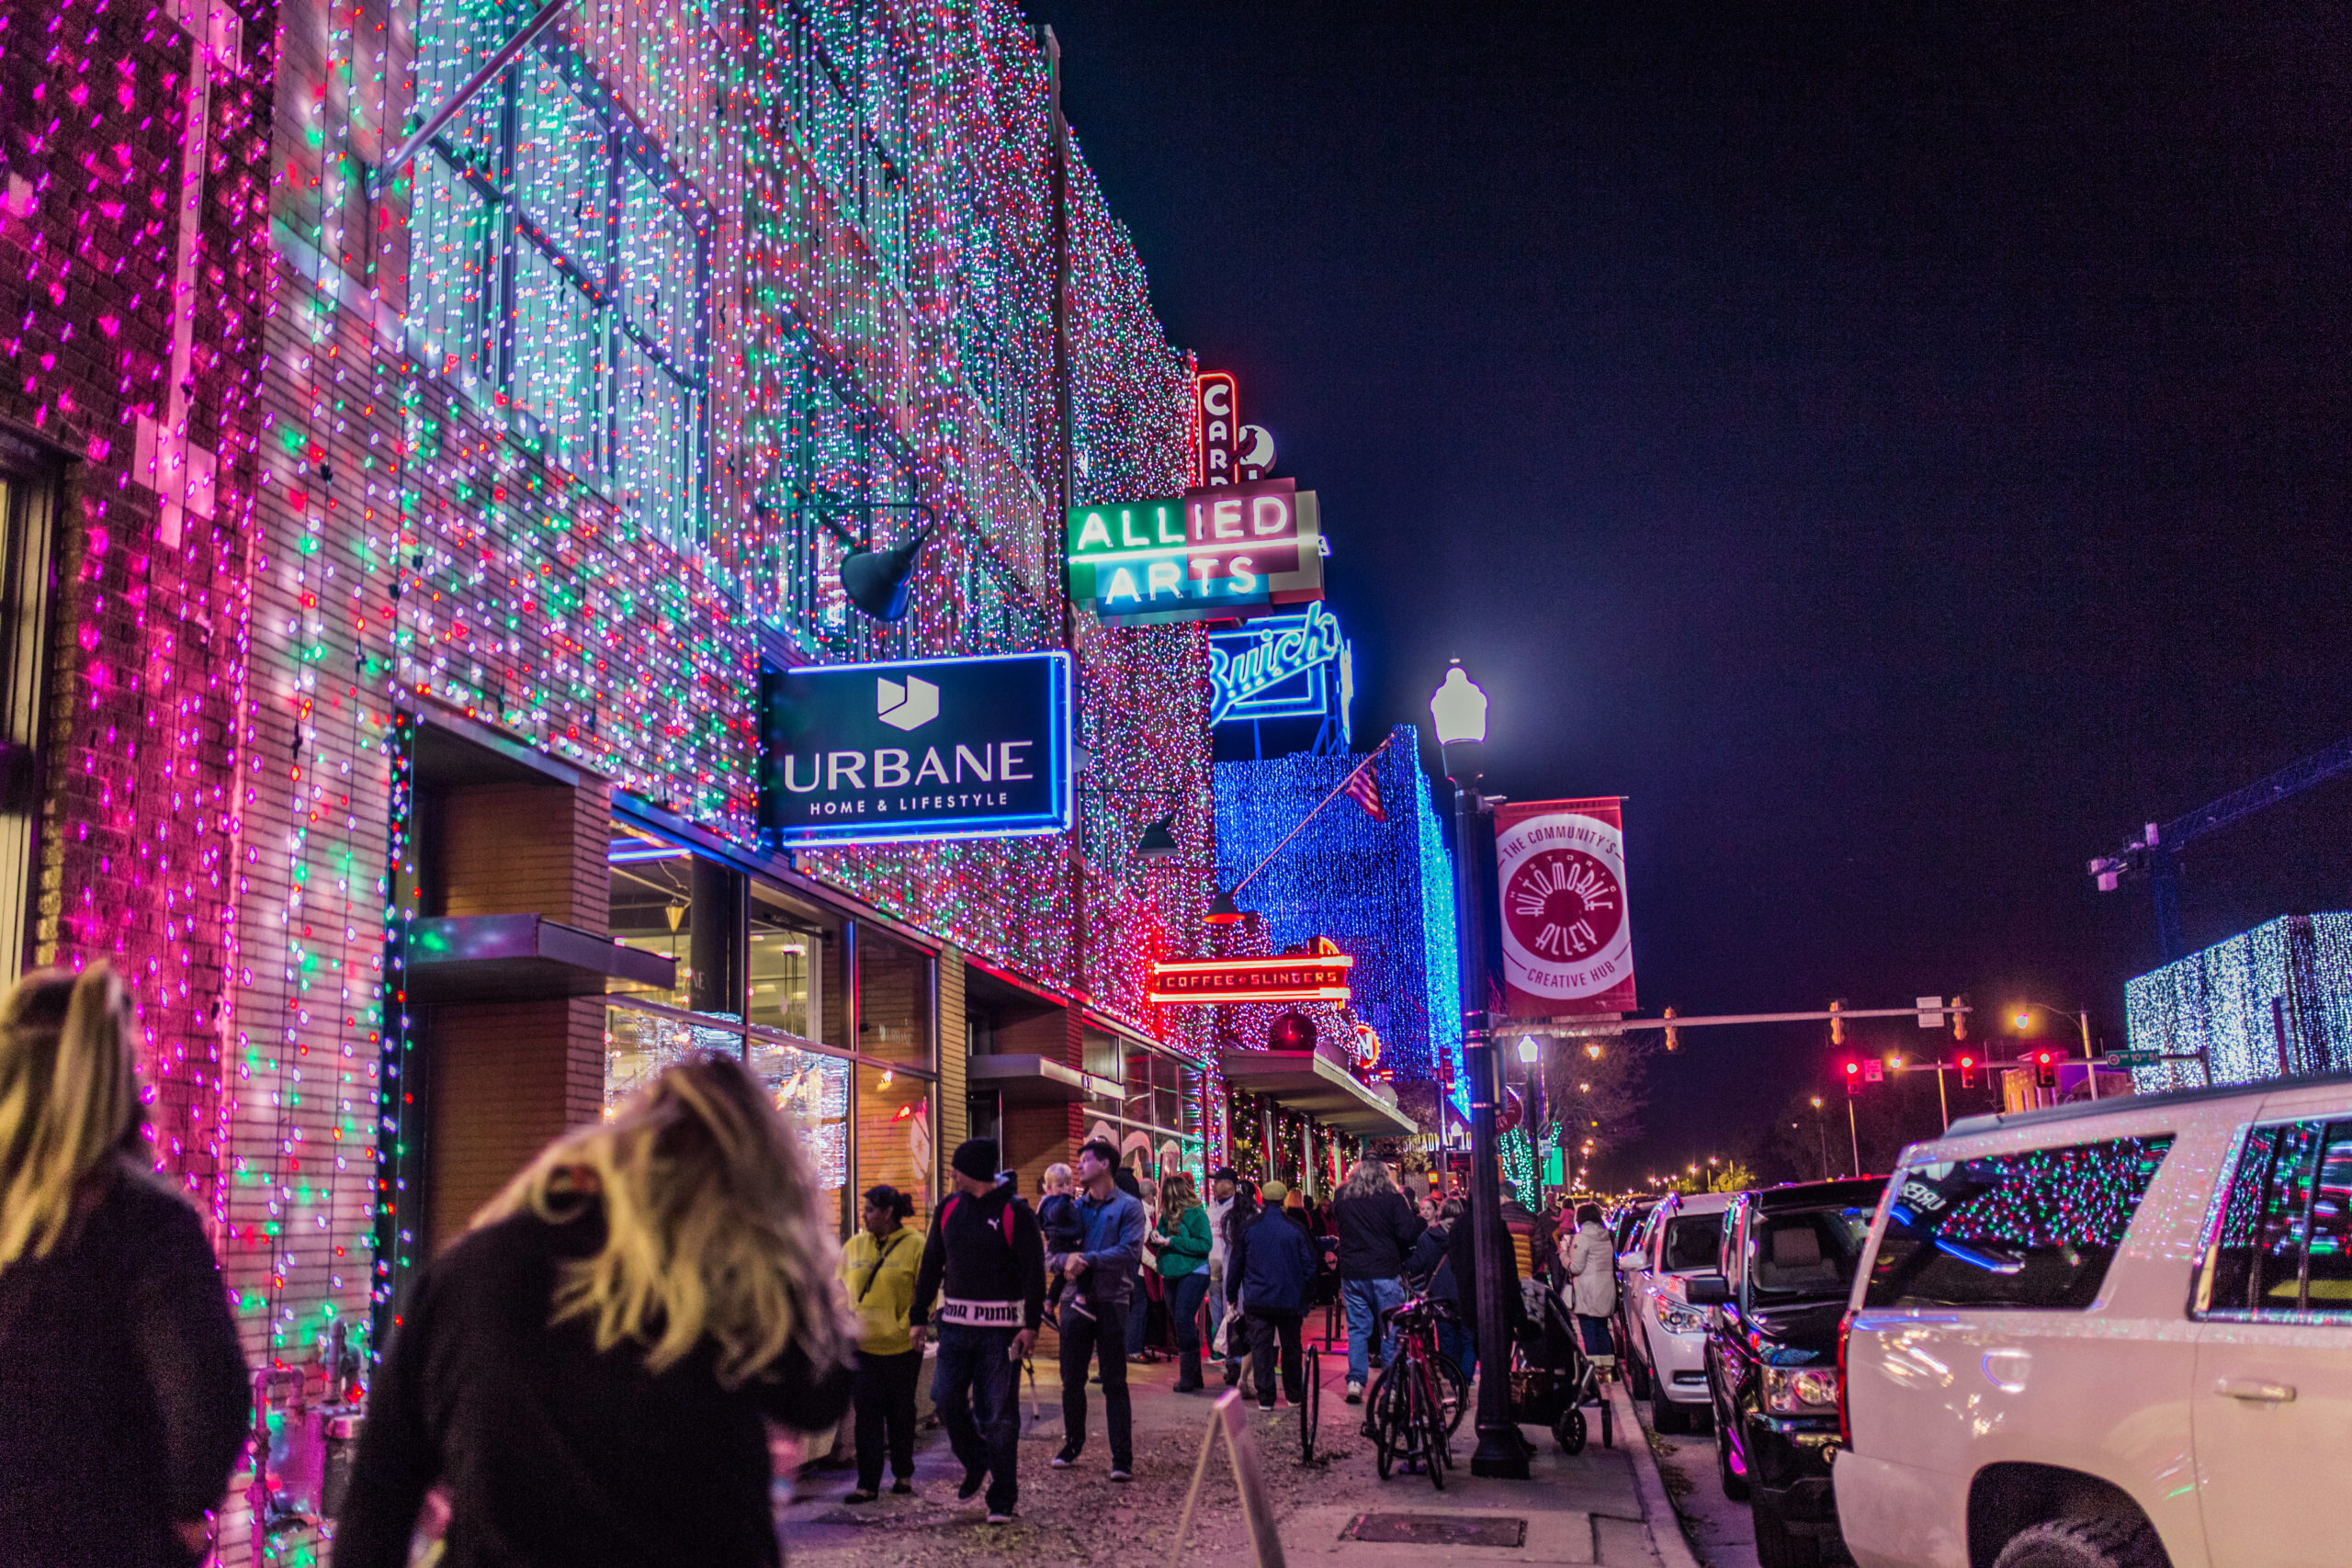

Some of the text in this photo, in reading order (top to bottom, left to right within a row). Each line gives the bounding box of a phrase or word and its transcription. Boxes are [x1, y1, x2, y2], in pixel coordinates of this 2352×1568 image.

[1077, 496, 1288, 550] ALLIED
[1105, 556, 1257, 605] ARTS
[1208, 600, 1337, 728] Buick
[785, 740, 1034, 793] URBANE
[809, 793, 1008, 816] HOME & LIFESTYLE
[1502, 825, 1617, 858] THE COMMUNITY'S
[1515, 862, 1613, 917] AUTOMOBILE
[1534, 919, 1598, 955] ALLEY
[1167, 972, 1338, 987] COFFEE SLINGERS
[1527, 961, 1615, 987] CREATIVE HUB
